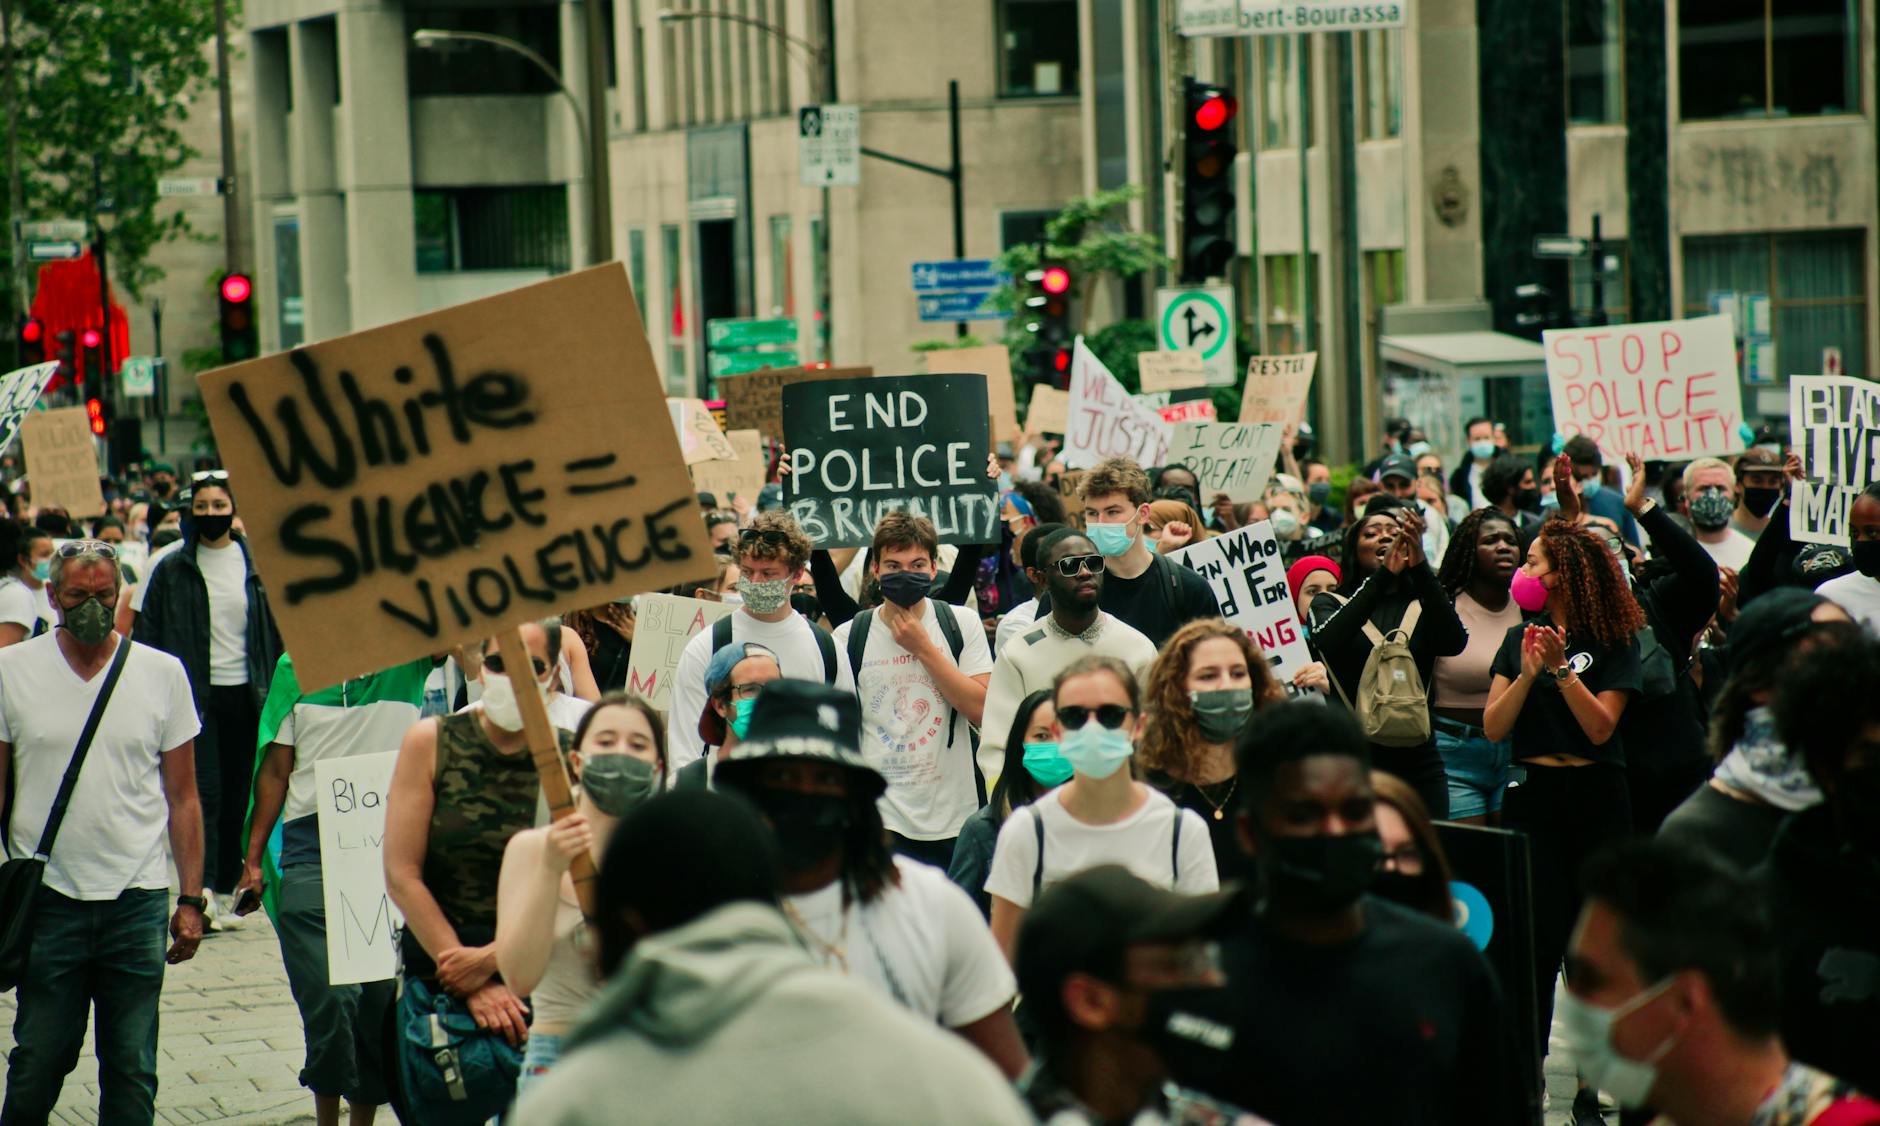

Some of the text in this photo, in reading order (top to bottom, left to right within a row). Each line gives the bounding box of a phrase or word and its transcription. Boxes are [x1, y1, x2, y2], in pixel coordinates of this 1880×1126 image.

[1553, 330, 1682, 380] STOP
[228, 332, 539, 490] White
[828, 390, 928, 432] END
[1565, 371, 1718, 421] POLICE
[790, 441, 977, 495] POLICE
[278, 459, 547, 604] SILENCE
[1216, 531, 1278, 568] Who
[379, 498, 692, 639] VIOLENCE
[331, 778, 389, 813] Bla
